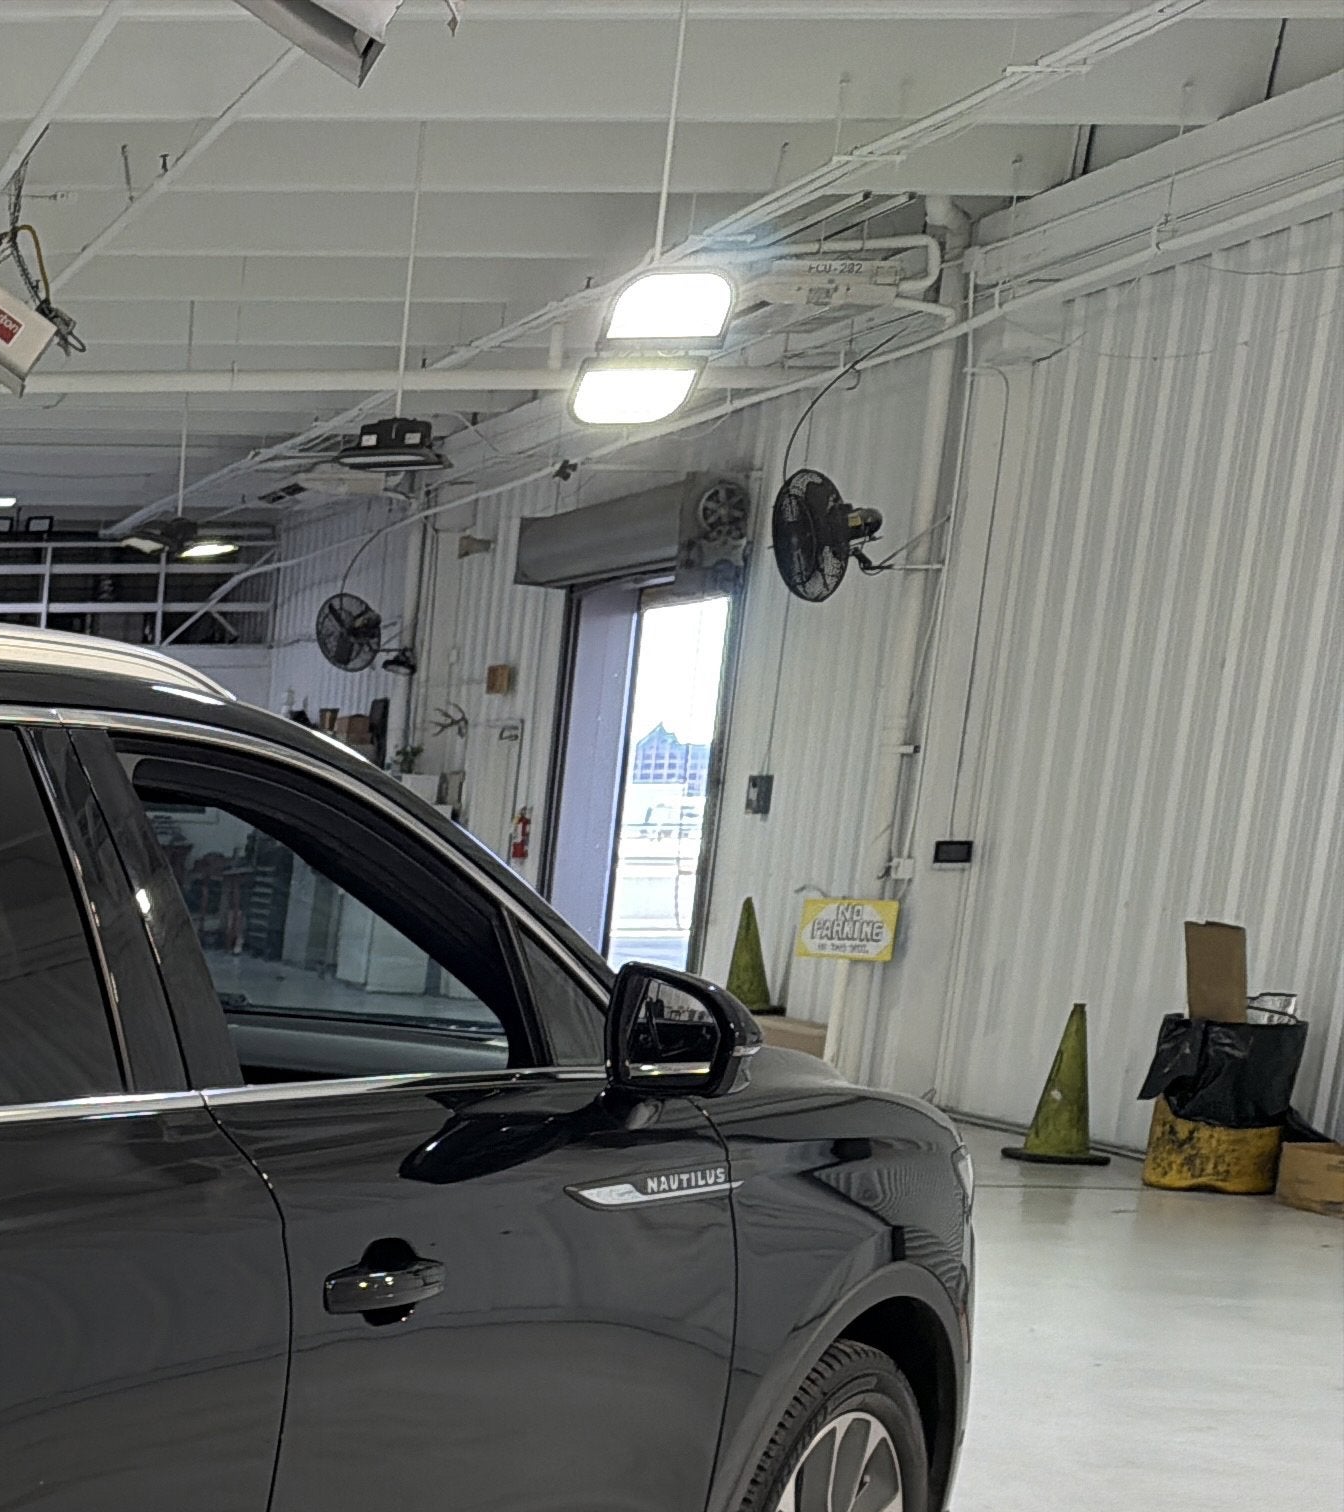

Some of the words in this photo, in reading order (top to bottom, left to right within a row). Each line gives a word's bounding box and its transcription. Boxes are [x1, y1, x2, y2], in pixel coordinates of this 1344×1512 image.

[835, 904, 865, 921] NO
[811, 919, 884, 942] PARKING
[646, 1167, 726, 1193] NAUTILUS
